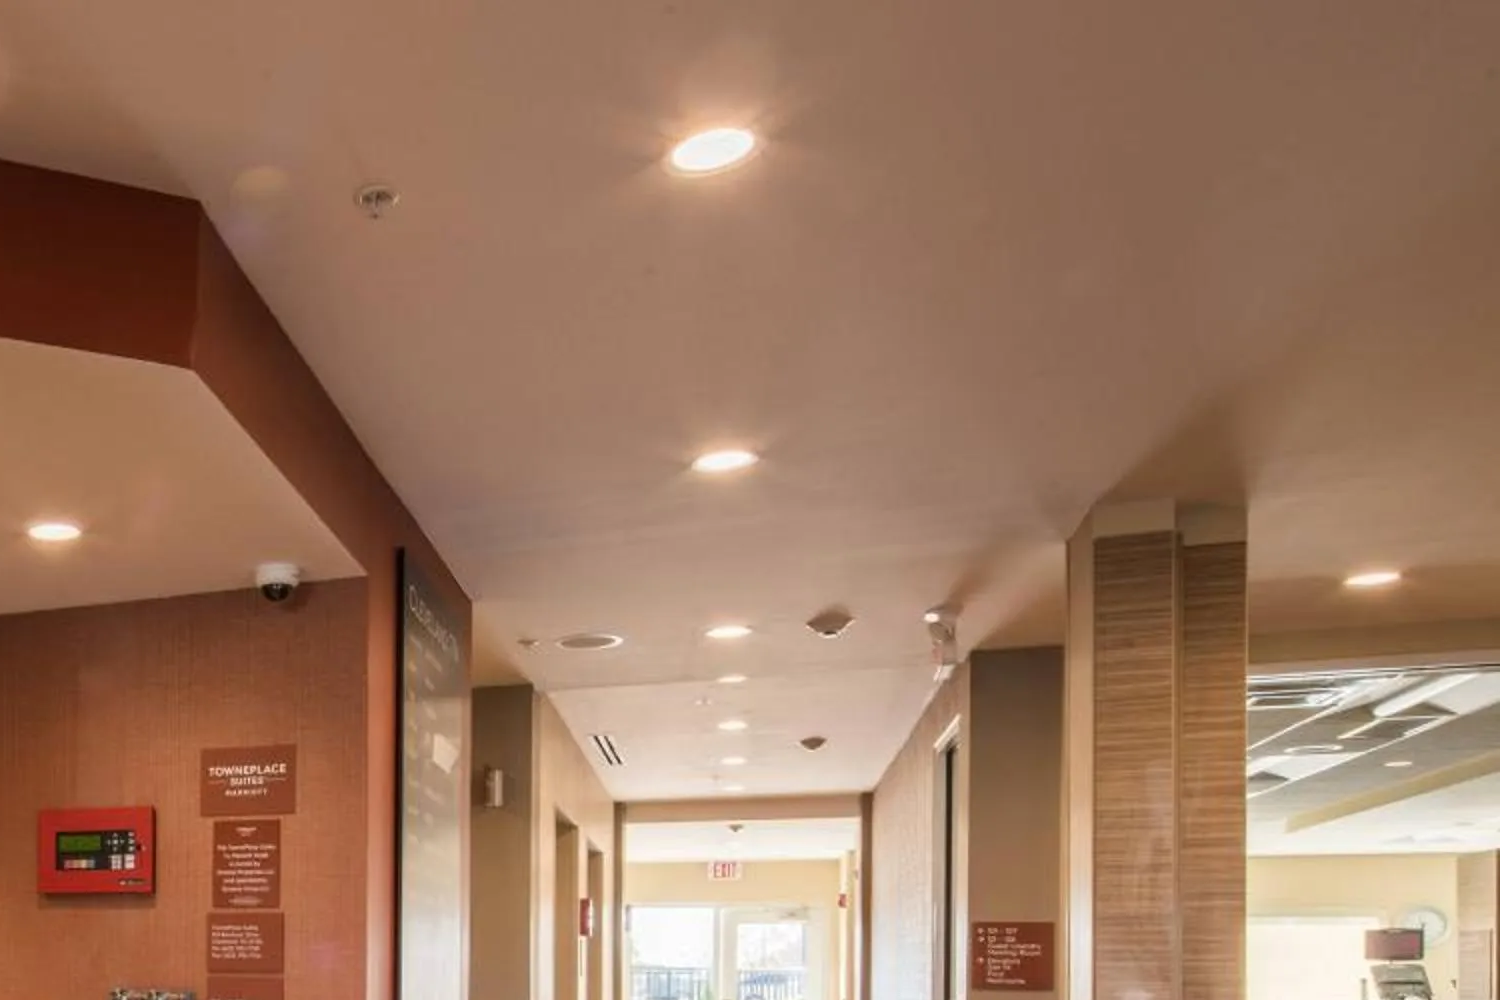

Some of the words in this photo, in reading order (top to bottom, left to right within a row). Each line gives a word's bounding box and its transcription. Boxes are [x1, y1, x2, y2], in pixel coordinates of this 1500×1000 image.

[208, 763, 287, 778] TOWNEPLACE
[229, 776, 264, 786] SUITES
[713, 861, 736, 878] EXIT
